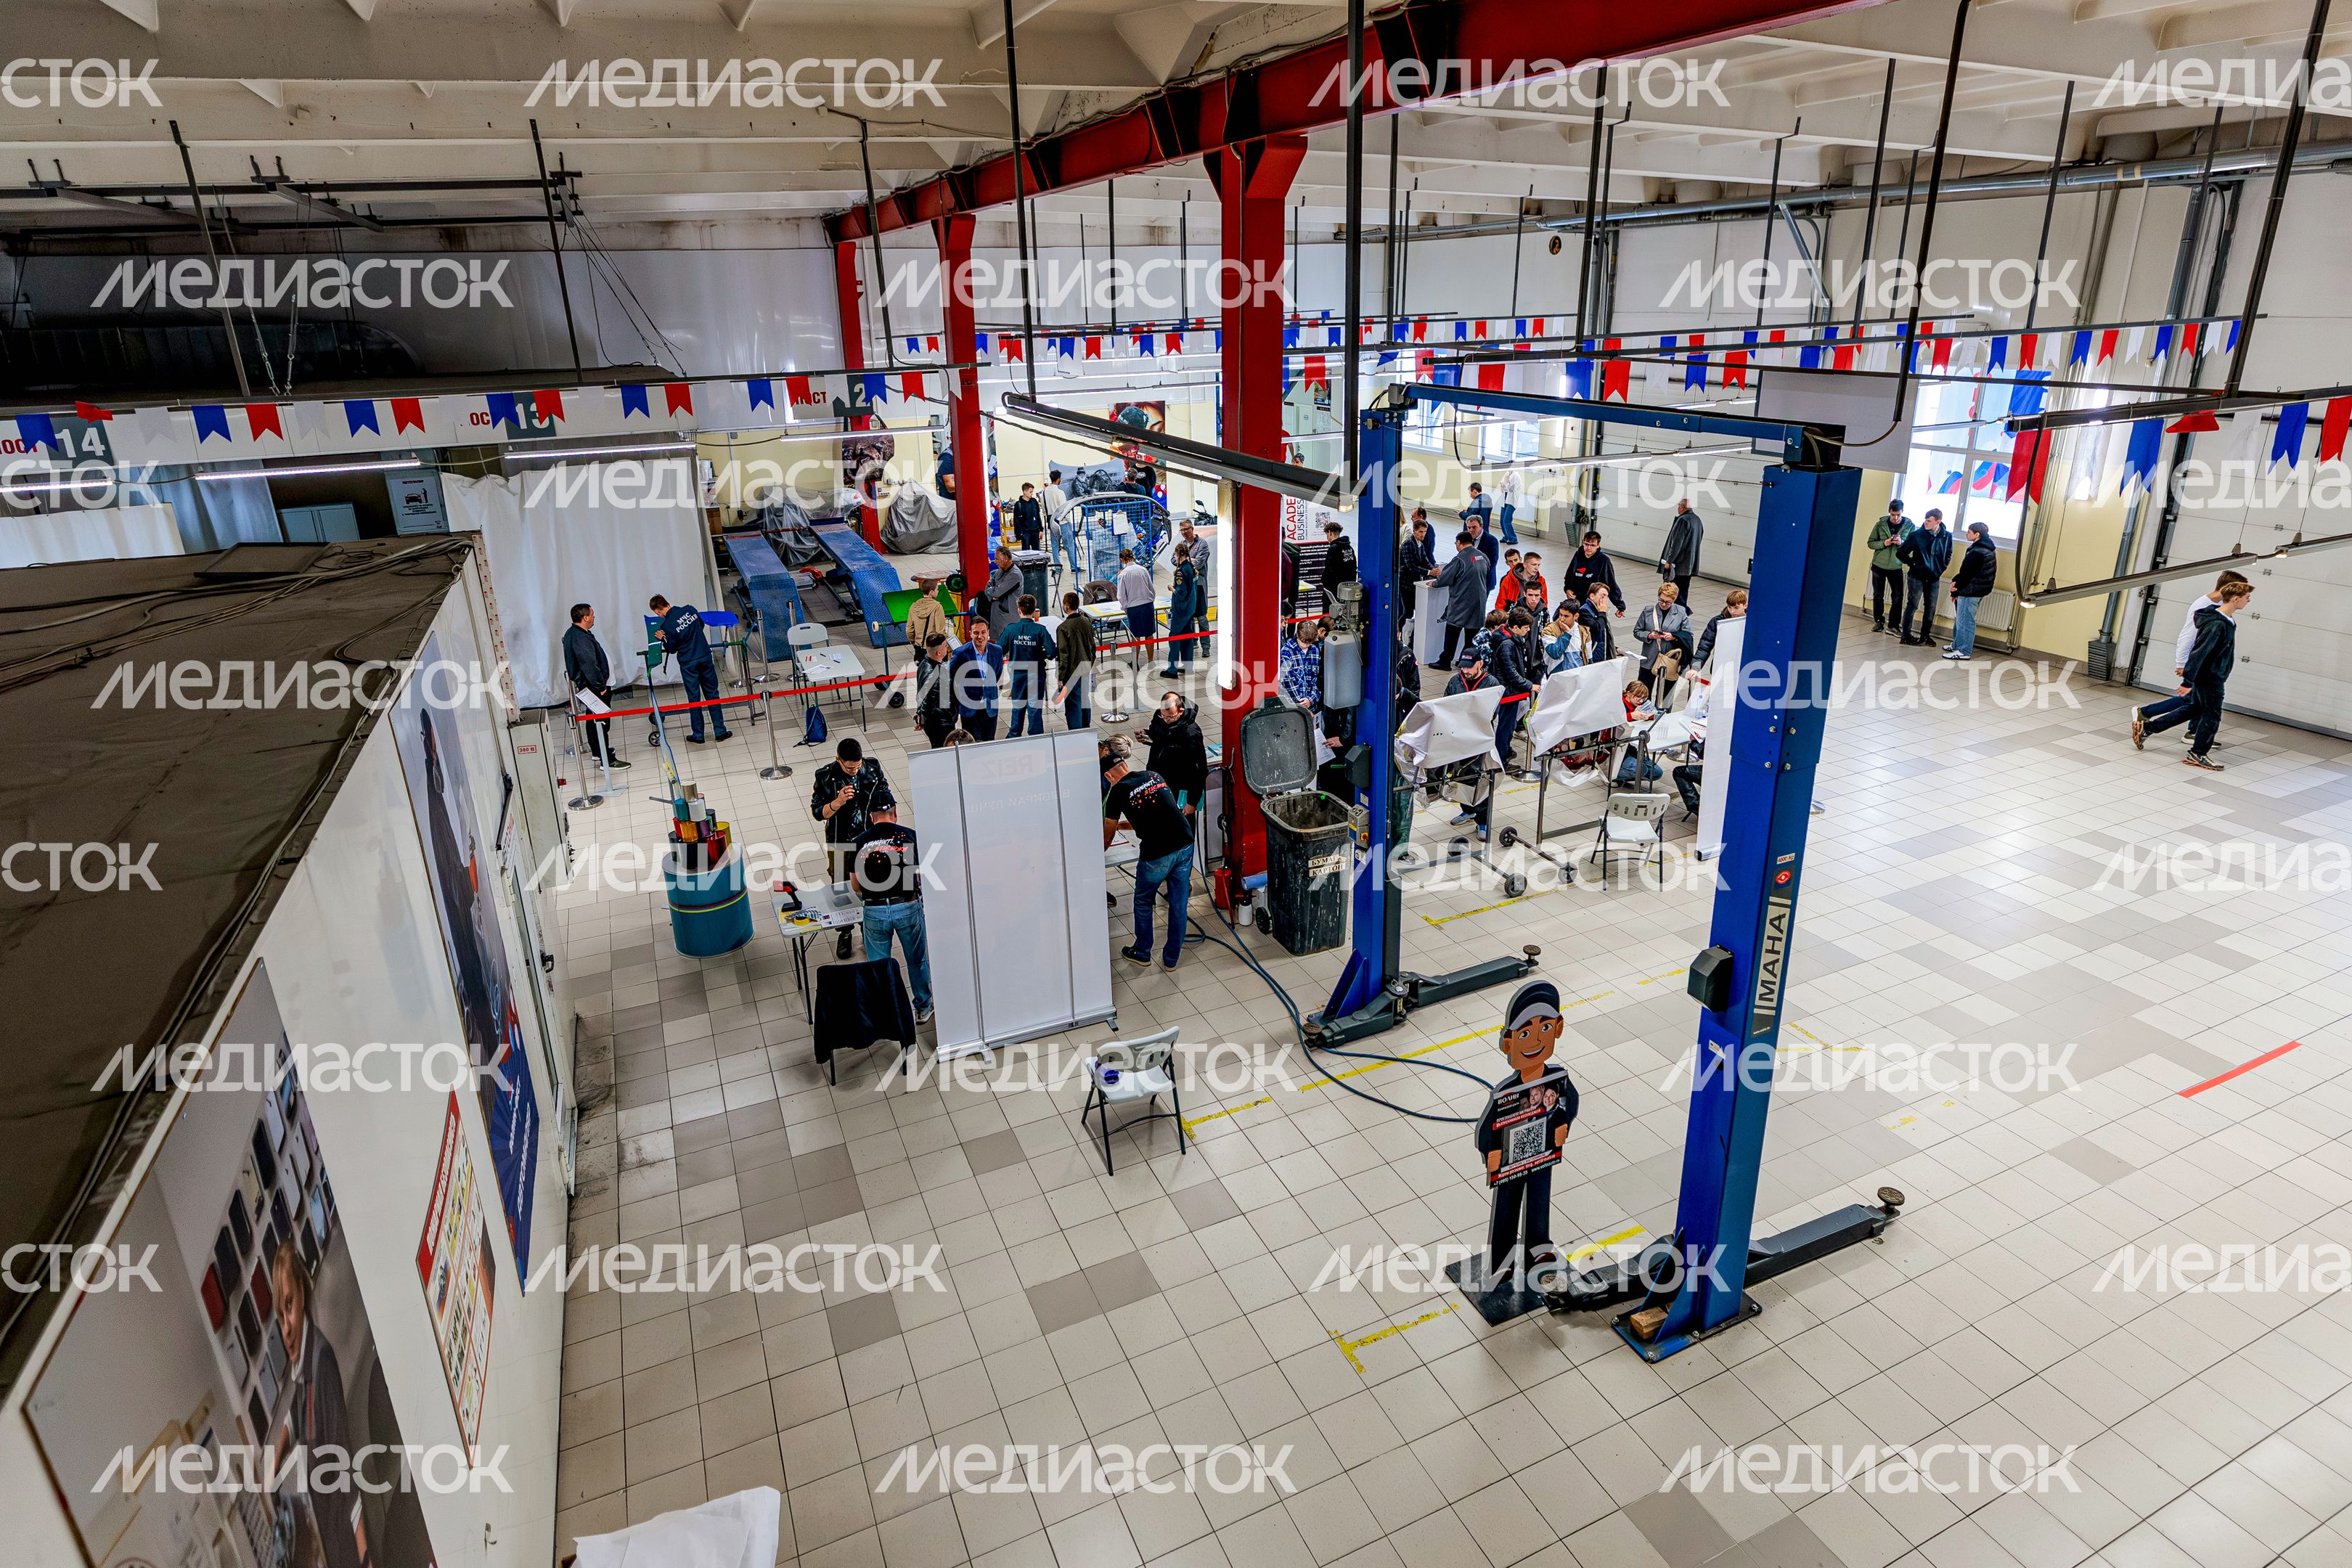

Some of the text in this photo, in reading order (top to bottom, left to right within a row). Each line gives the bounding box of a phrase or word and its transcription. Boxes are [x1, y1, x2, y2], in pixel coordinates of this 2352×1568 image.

[55, 427, 106, 458] 14
[1286, 494, 1297, 540] ACADE
[675, 613, 698, 633] РОССИИ
[677, 612, 690, 624] МЧС
[1312, 864, 1343, 876] КАРТОН
[1758, 912, 1787, 1003] MAHA
